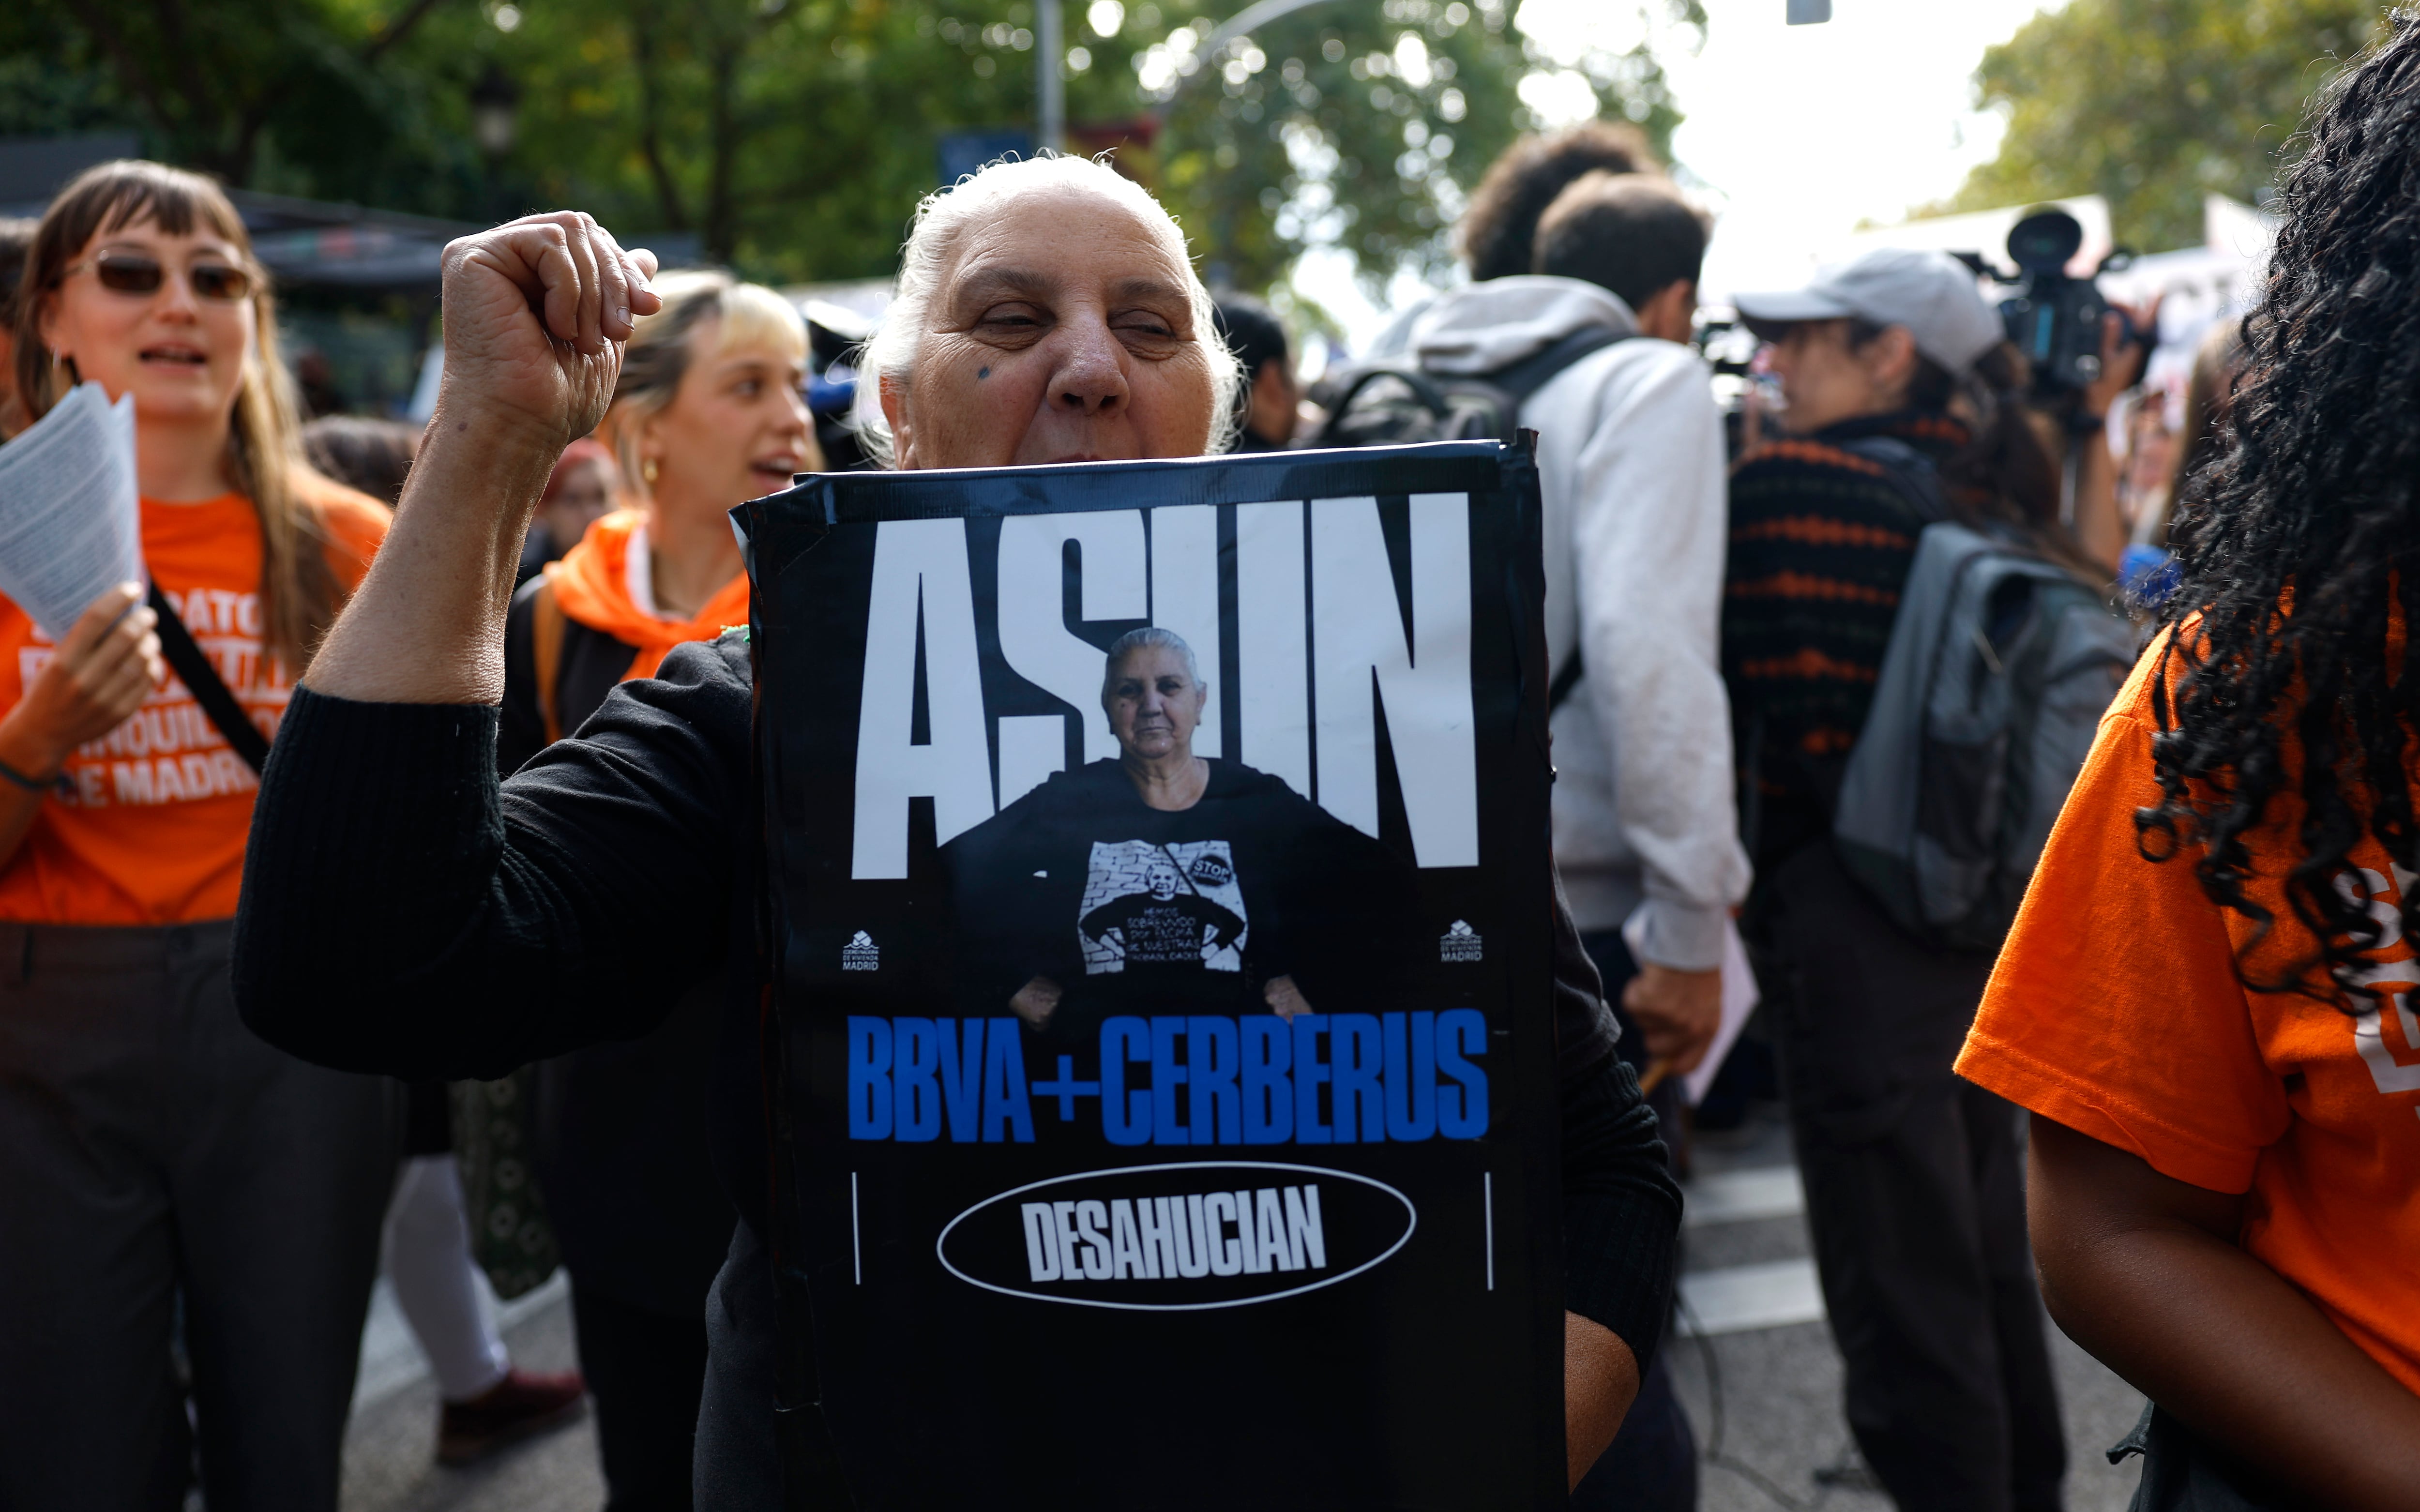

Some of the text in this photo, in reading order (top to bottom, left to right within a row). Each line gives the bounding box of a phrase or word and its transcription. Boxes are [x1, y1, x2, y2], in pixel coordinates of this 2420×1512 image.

[851, 491, 1480, 880] ASUN
[1194, 860, 1229, 877] STOP
[1441, 951, 1483, 962] MADRID
[843, 961, 879, 971] MADRID
[1021, 1184, 1326, 1282] DESAHUCIAN
